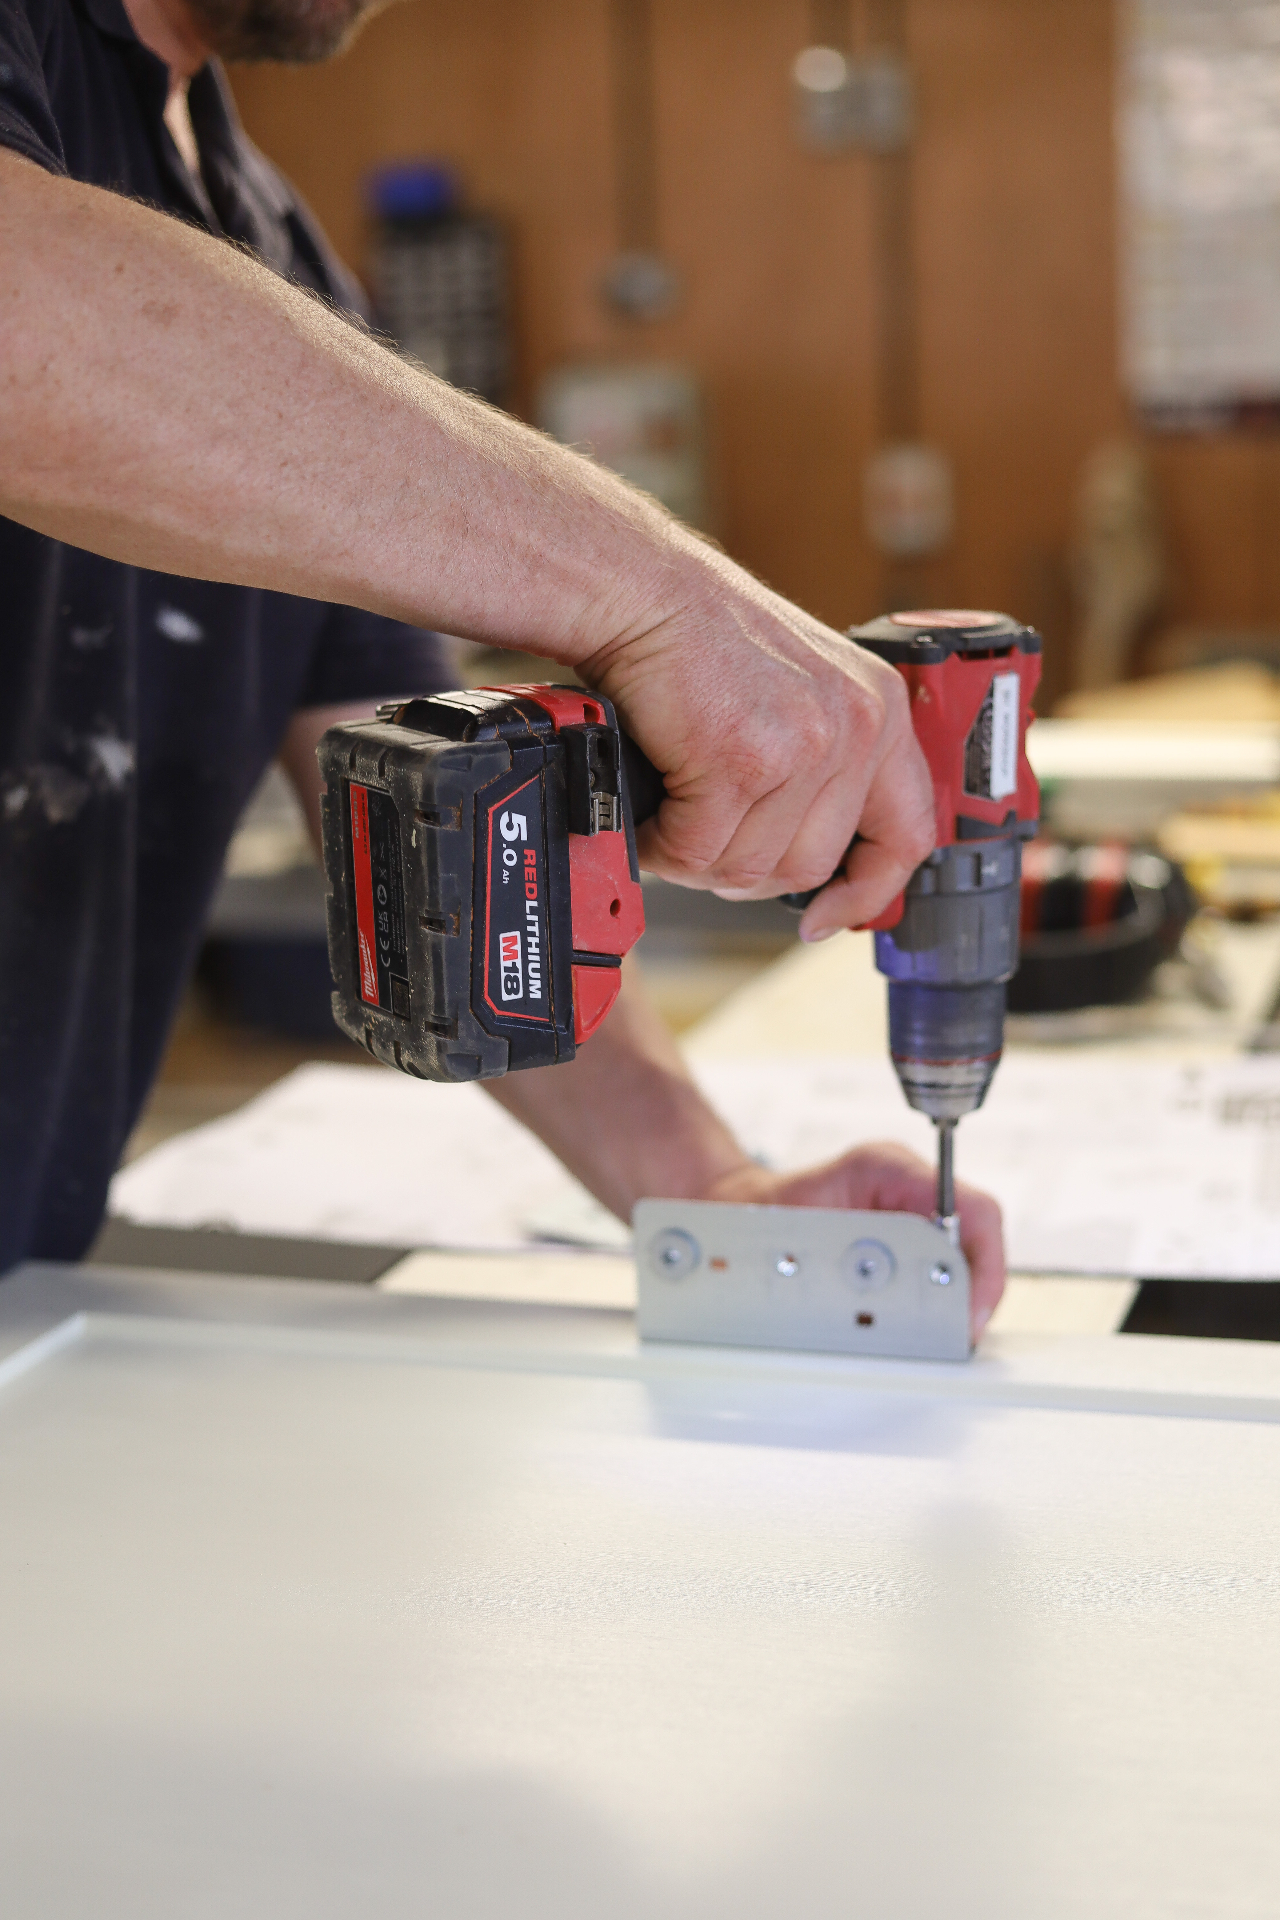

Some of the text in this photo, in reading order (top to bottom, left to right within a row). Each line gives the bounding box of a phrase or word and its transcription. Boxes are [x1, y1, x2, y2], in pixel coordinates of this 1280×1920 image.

[499, 810, 528, 884] 5.0 Ah
[523, 848, 542, 999] REDLITHIUM
[360, 930, 375, 998] Milwaukee
[501, 934, 521, 996] M18
